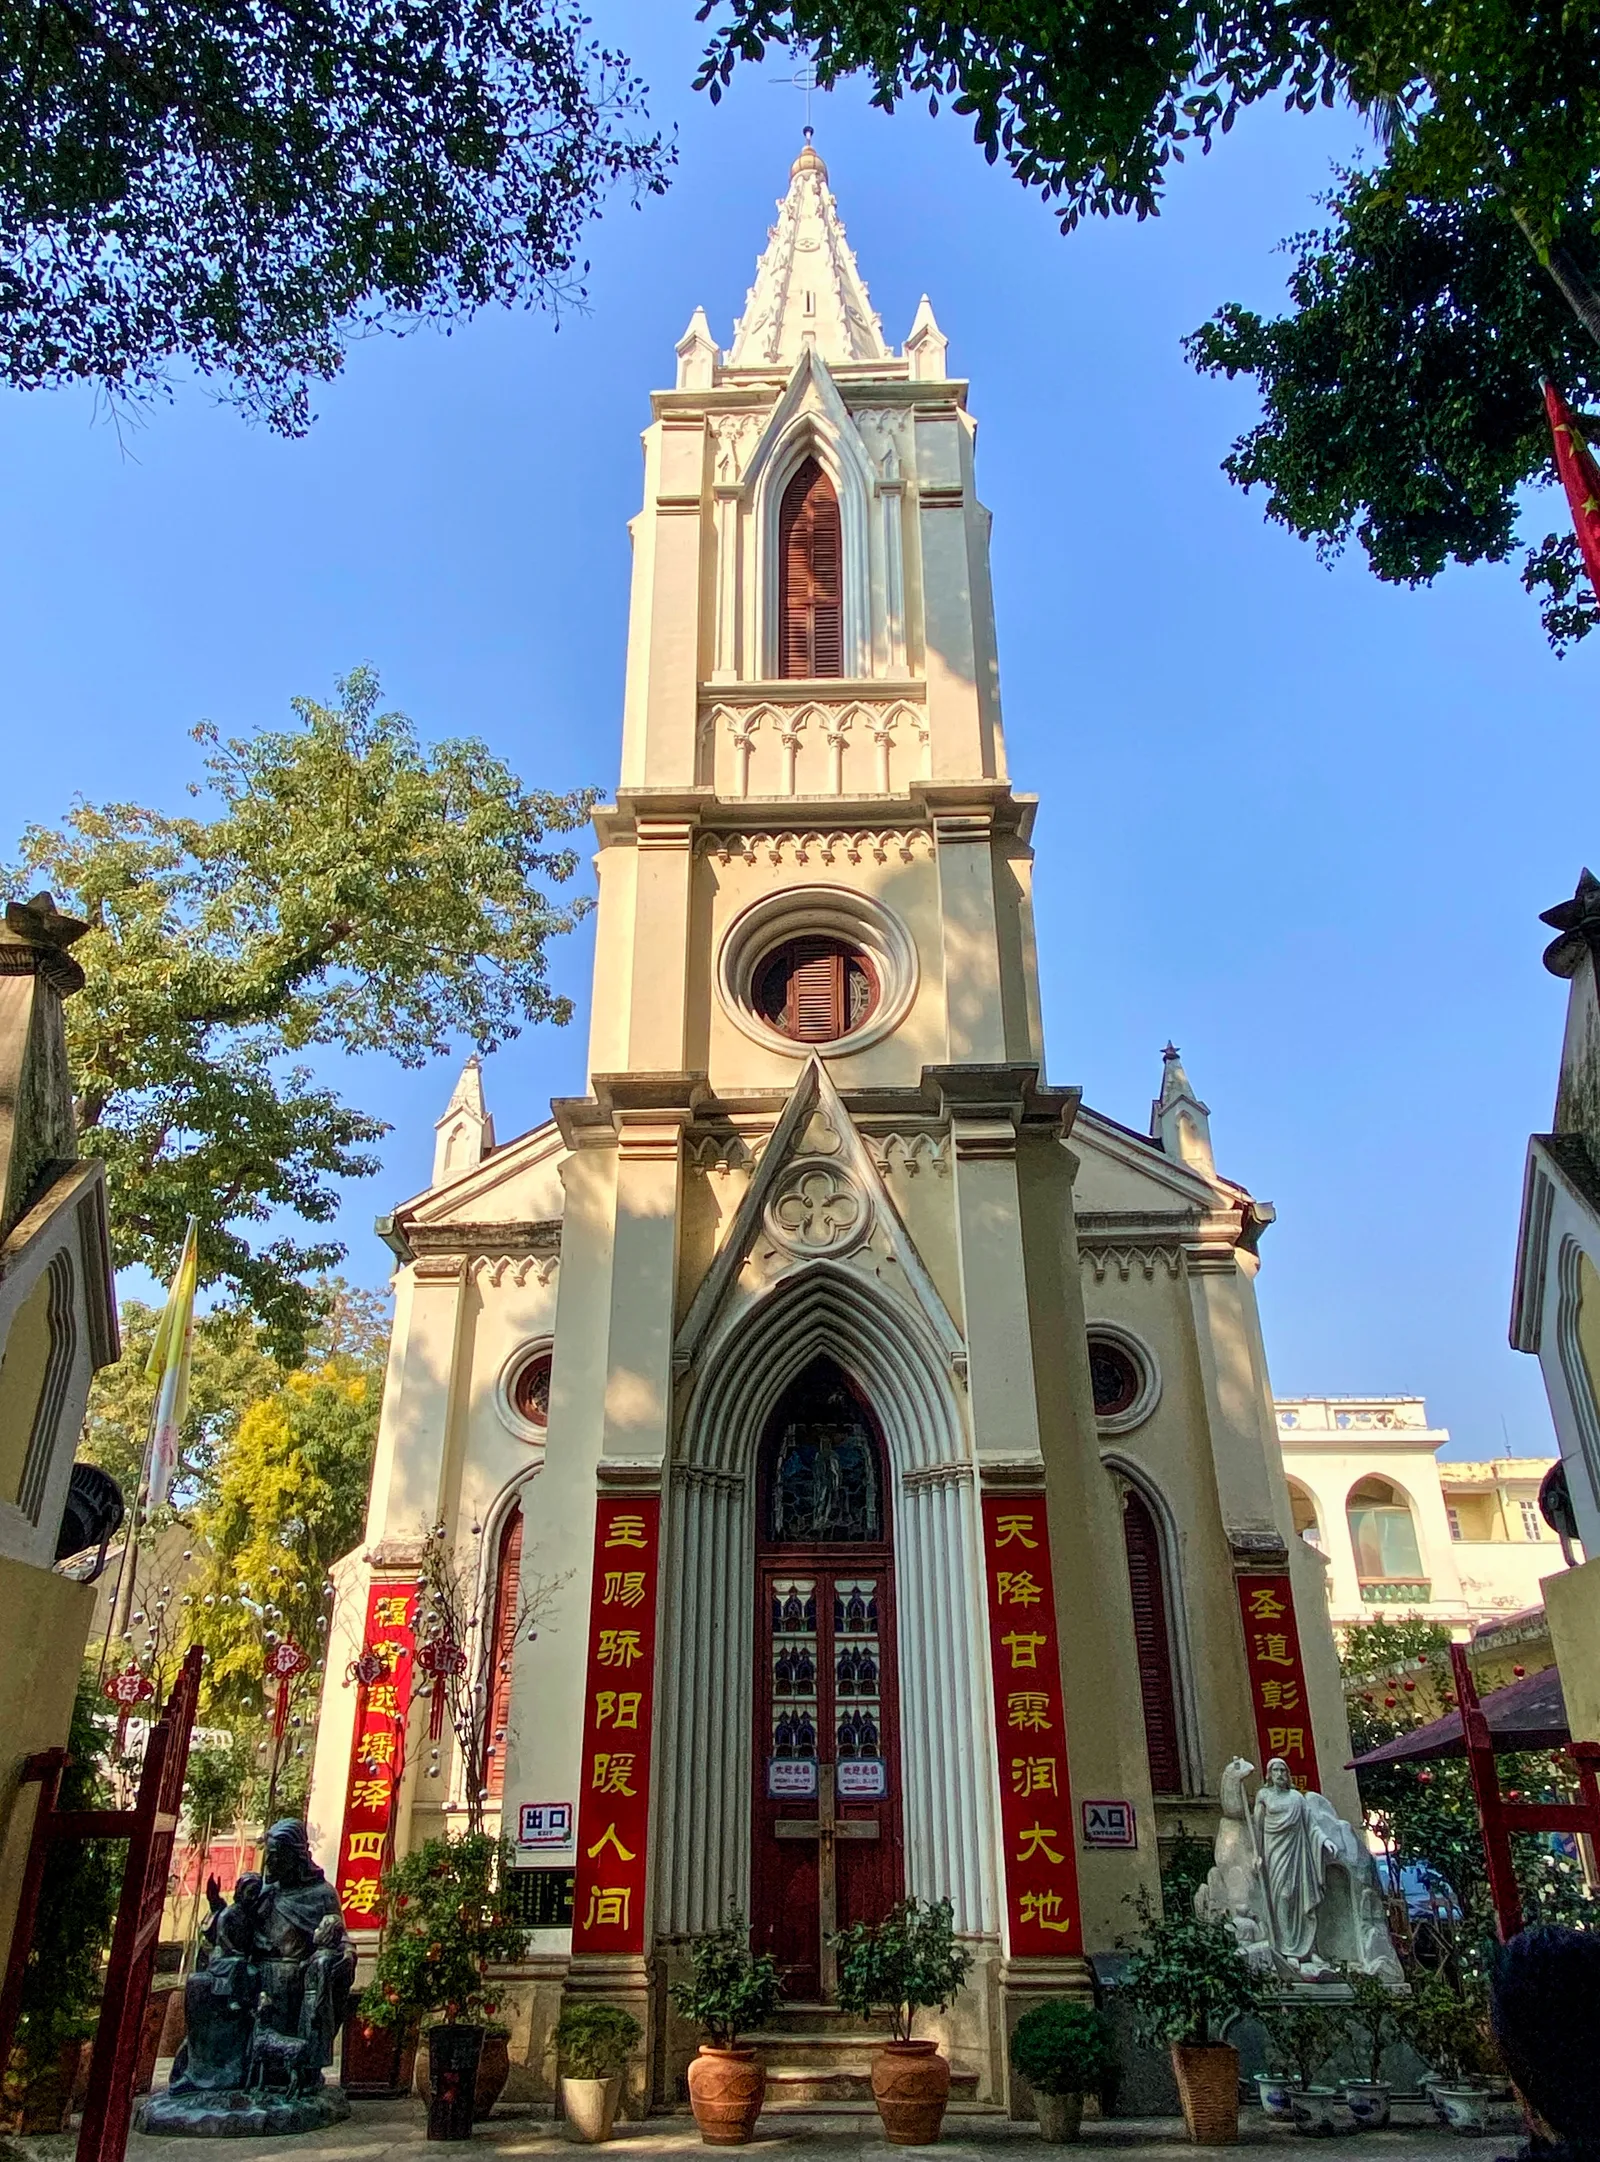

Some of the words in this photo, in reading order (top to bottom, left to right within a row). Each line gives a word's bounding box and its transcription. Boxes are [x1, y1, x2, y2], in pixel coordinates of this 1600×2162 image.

[526, 1810, 565, 1829] 出口
[582, 1514, 648, 1932] 主赐骄阳暖人间
[995, 1514, 1069, 1933] 天降甘霖润大地
[1089, 1808, 1125, 1828] 入口
